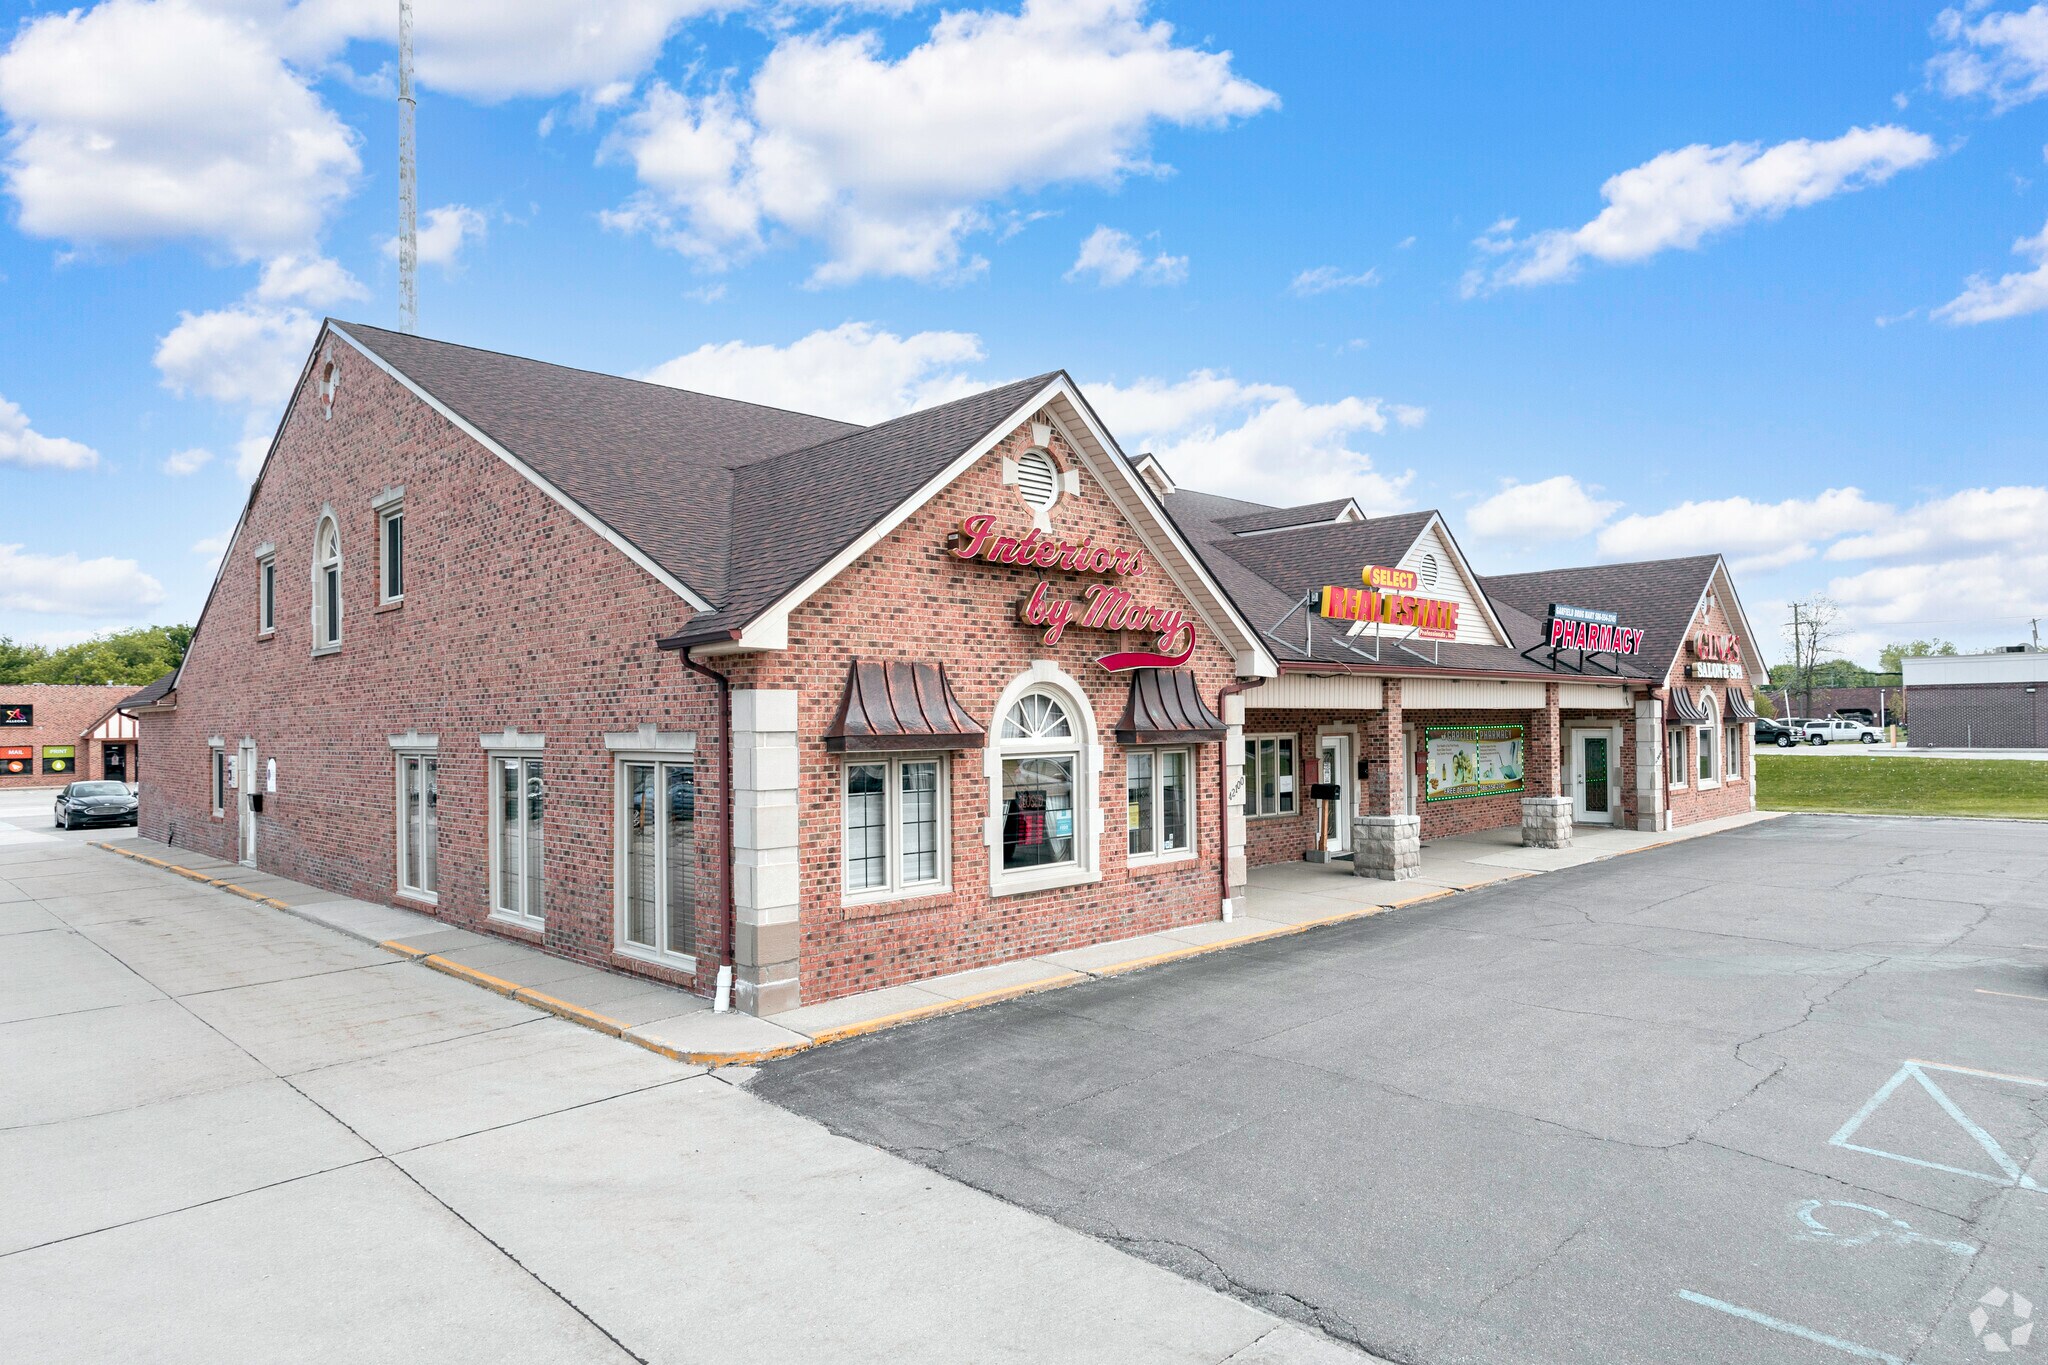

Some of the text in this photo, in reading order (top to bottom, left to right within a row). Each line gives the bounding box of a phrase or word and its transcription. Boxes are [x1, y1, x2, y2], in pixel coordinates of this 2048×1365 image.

[952, 514, 1148, 577] Interiors
[1372, 568, 1414, 589] SELECT
[1026, 581, 1190, 655] by Mary
[1327, 586, 1459, 630] REAL ESTATE
[1550, 618, 1644, 655] PHARMACY
[1697, 661, 1743, 680] SALON & SPA
[1447, 729, 1512, 741] GARFIELD PHARMACY
